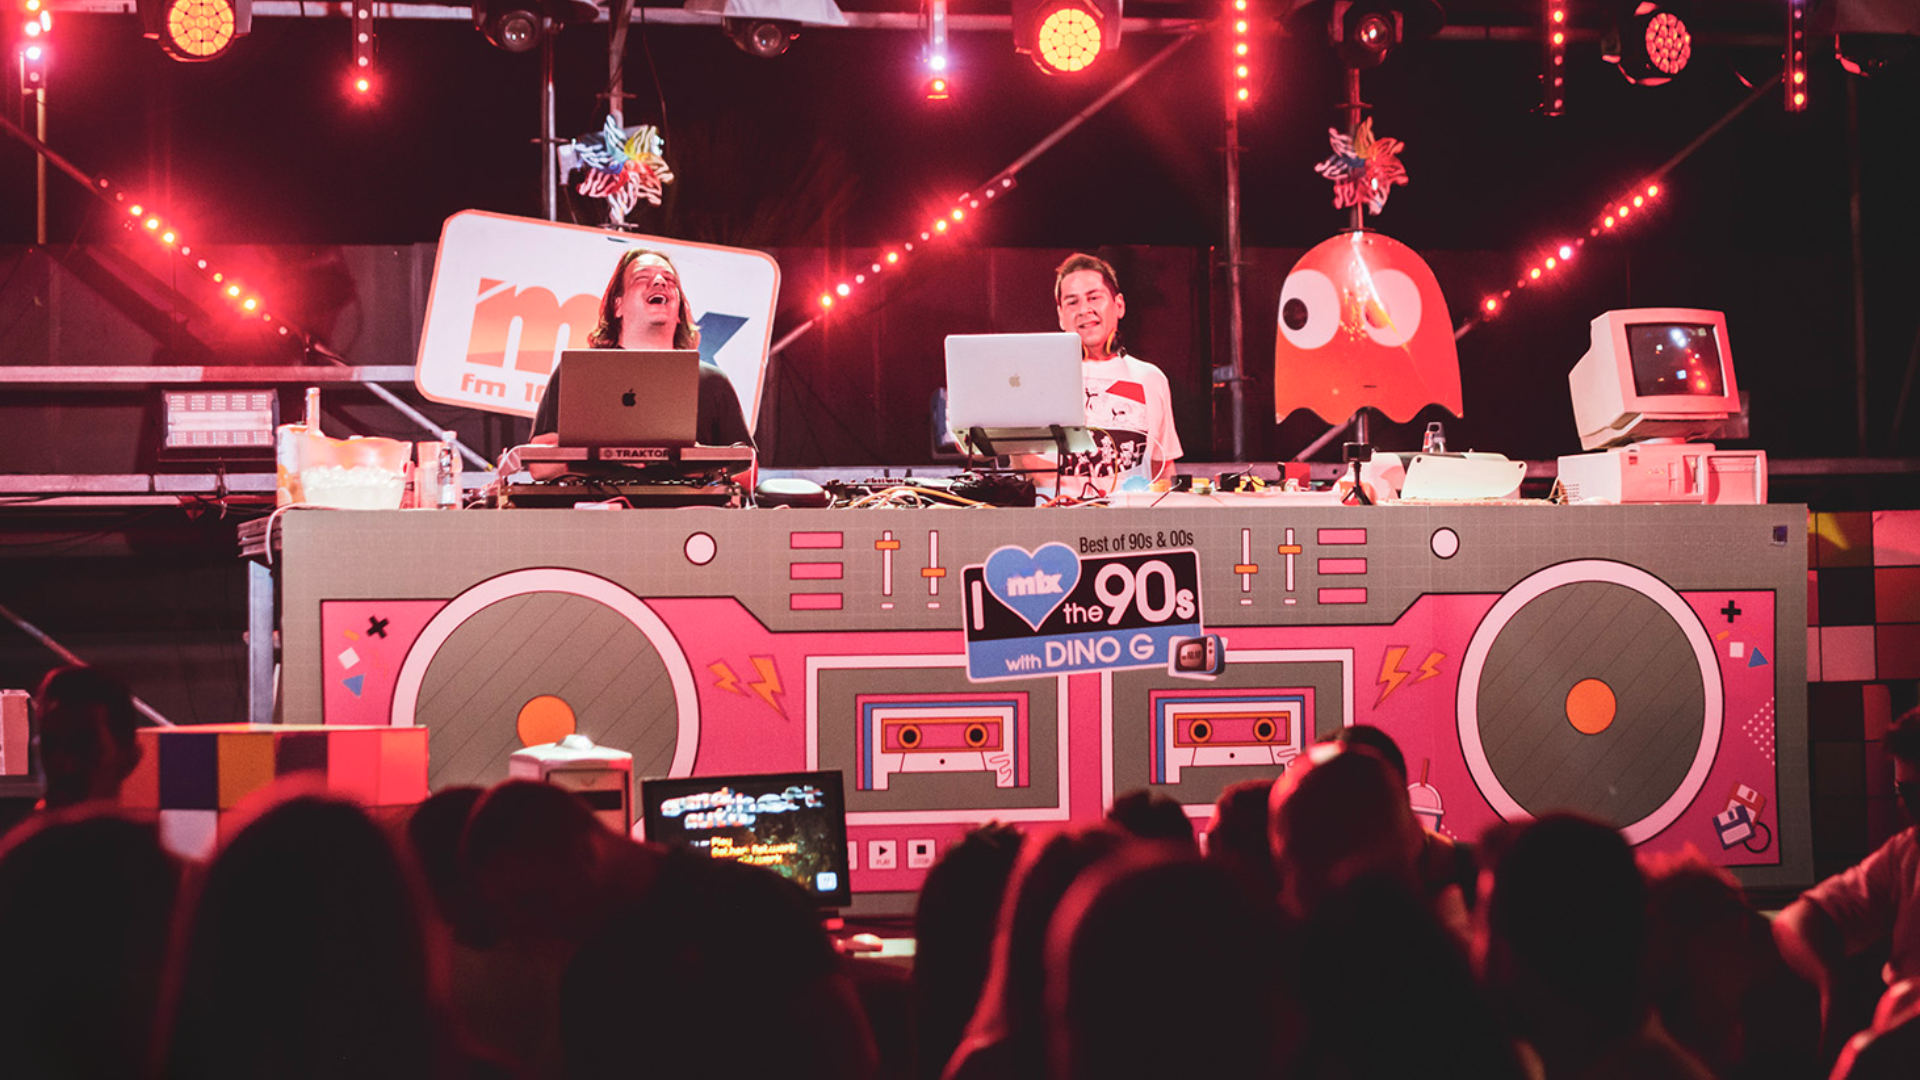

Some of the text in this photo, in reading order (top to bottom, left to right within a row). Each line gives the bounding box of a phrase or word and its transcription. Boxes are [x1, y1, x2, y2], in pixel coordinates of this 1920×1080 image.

[460, 373, 506, 398] fm
[1079, 529, 1194, 553] Best of 90s & 00s
[971, 580, 985, 631] I
[1063, 602, 1104, 625] the
[1094, 559, 1196, 625] 90s
[1005, 653, 1042, 672] with
[1045, 636, 1121, 668] DINO
[1129, 633, 1155, 660] G
